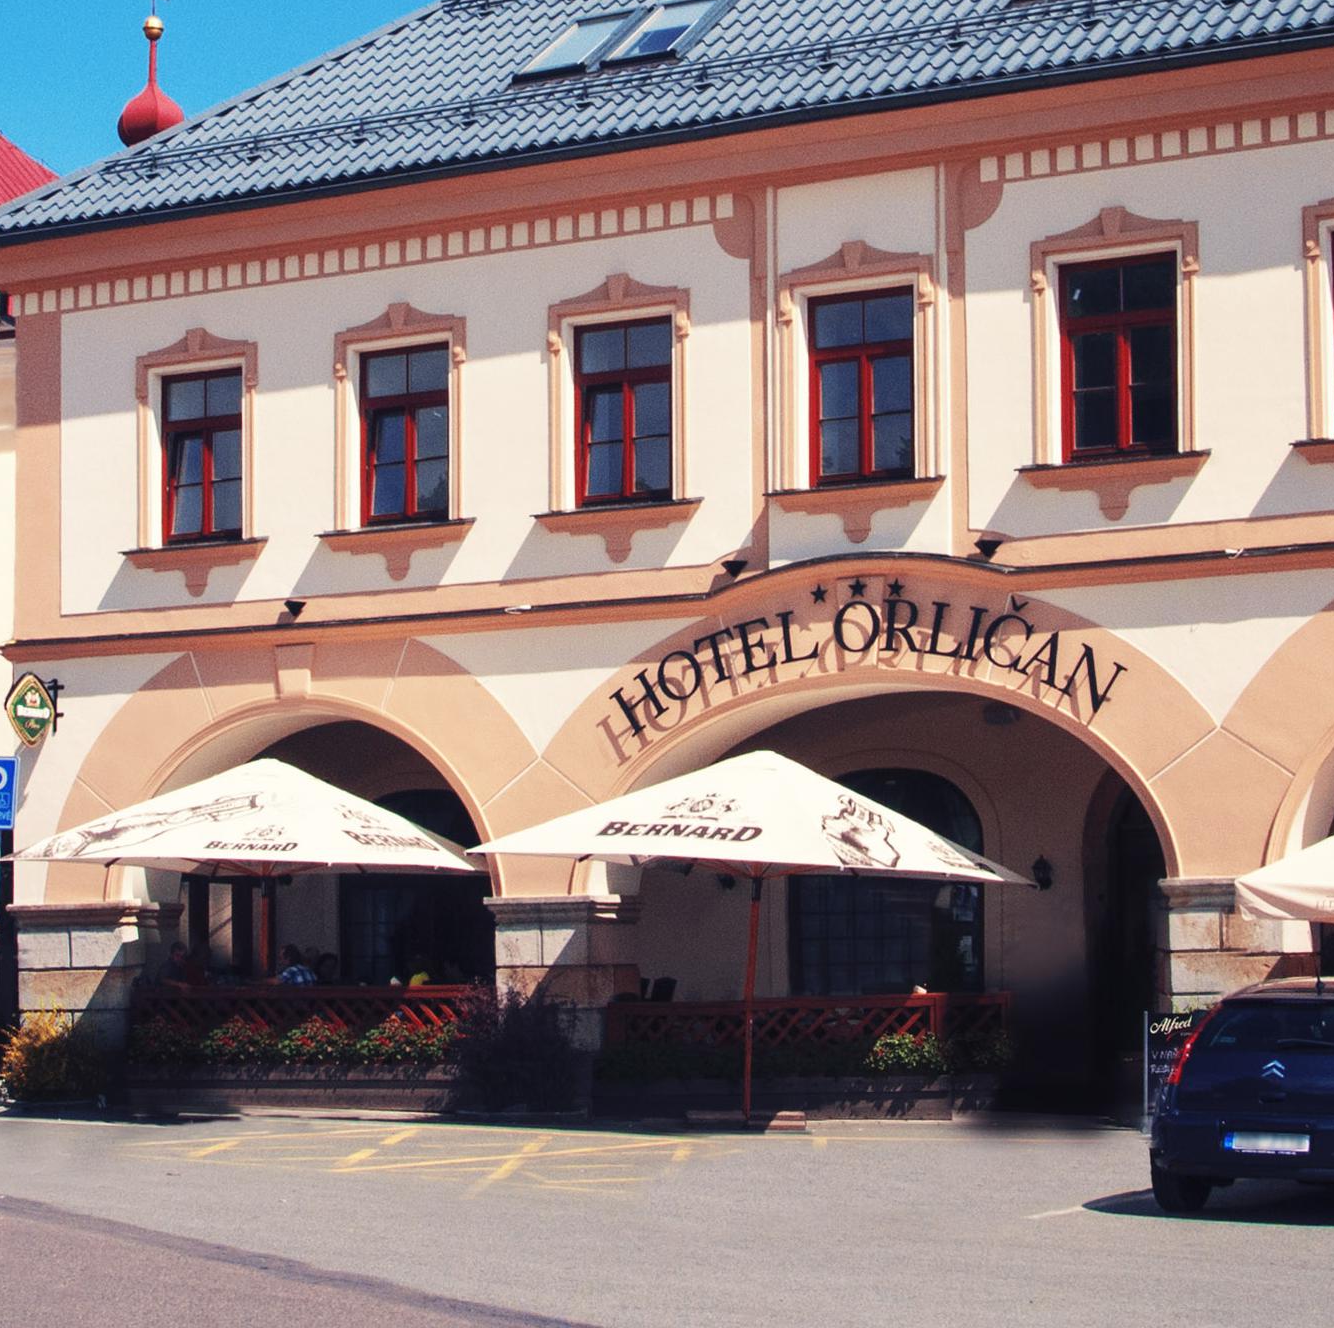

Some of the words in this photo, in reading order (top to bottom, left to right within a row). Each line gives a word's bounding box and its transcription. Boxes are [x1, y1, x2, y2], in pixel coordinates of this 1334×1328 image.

[609, 610, 819, 737] HOTEL
[832, 593, 1128, 715] ORLIČAN
[341, 829, 440, 852] BERNARD
[596, 821, 763, 842] BERNARD
[204, 840, 299, 852] BERNARD
[1150, 1014, 1193, 1035] Alfred
